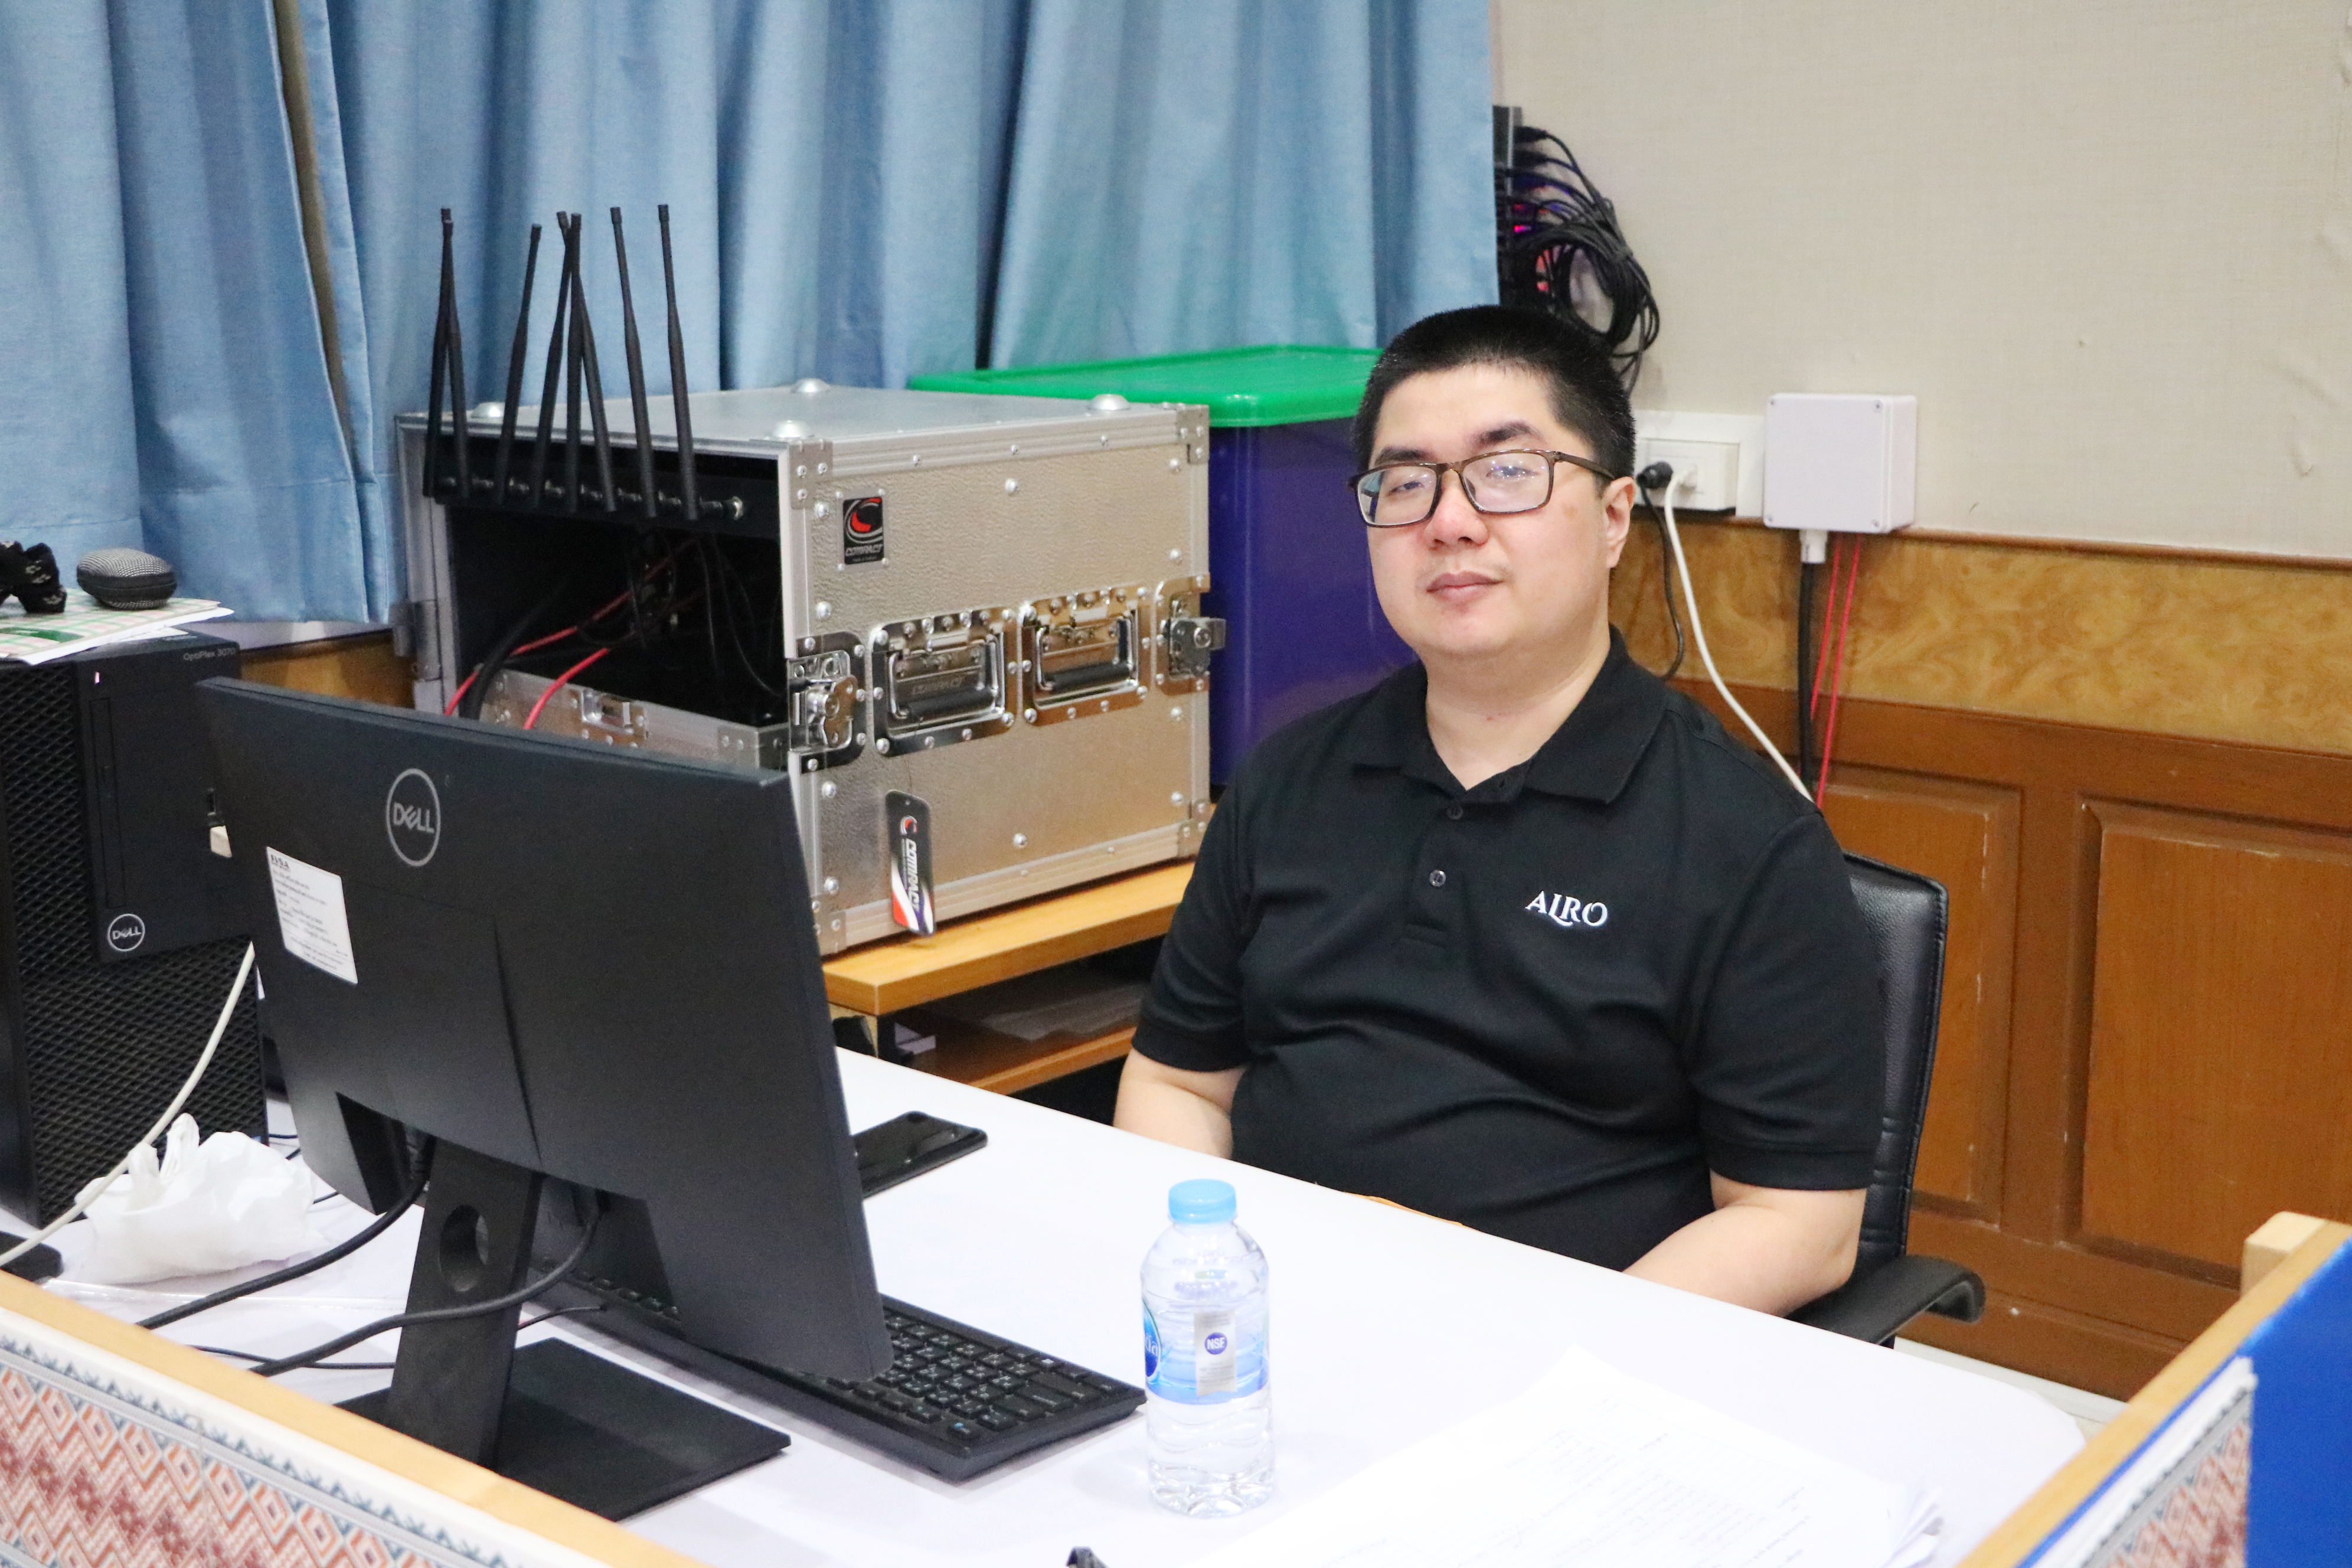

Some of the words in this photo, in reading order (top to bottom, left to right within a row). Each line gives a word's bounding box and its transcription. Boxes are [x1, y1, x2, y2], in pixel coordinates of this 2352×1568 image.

[184, 650, 215, 661] OptiPlex
[217, 647, 236, 656] 3070
[393, 802, 435, 834] DELL
[905, 838, 920, 912] COMPACT
[1524, 890, 1608, 926] AIRO
[112, 926, 142, 940] DELL
[1206, 1337, 1225, 1350] NSF
